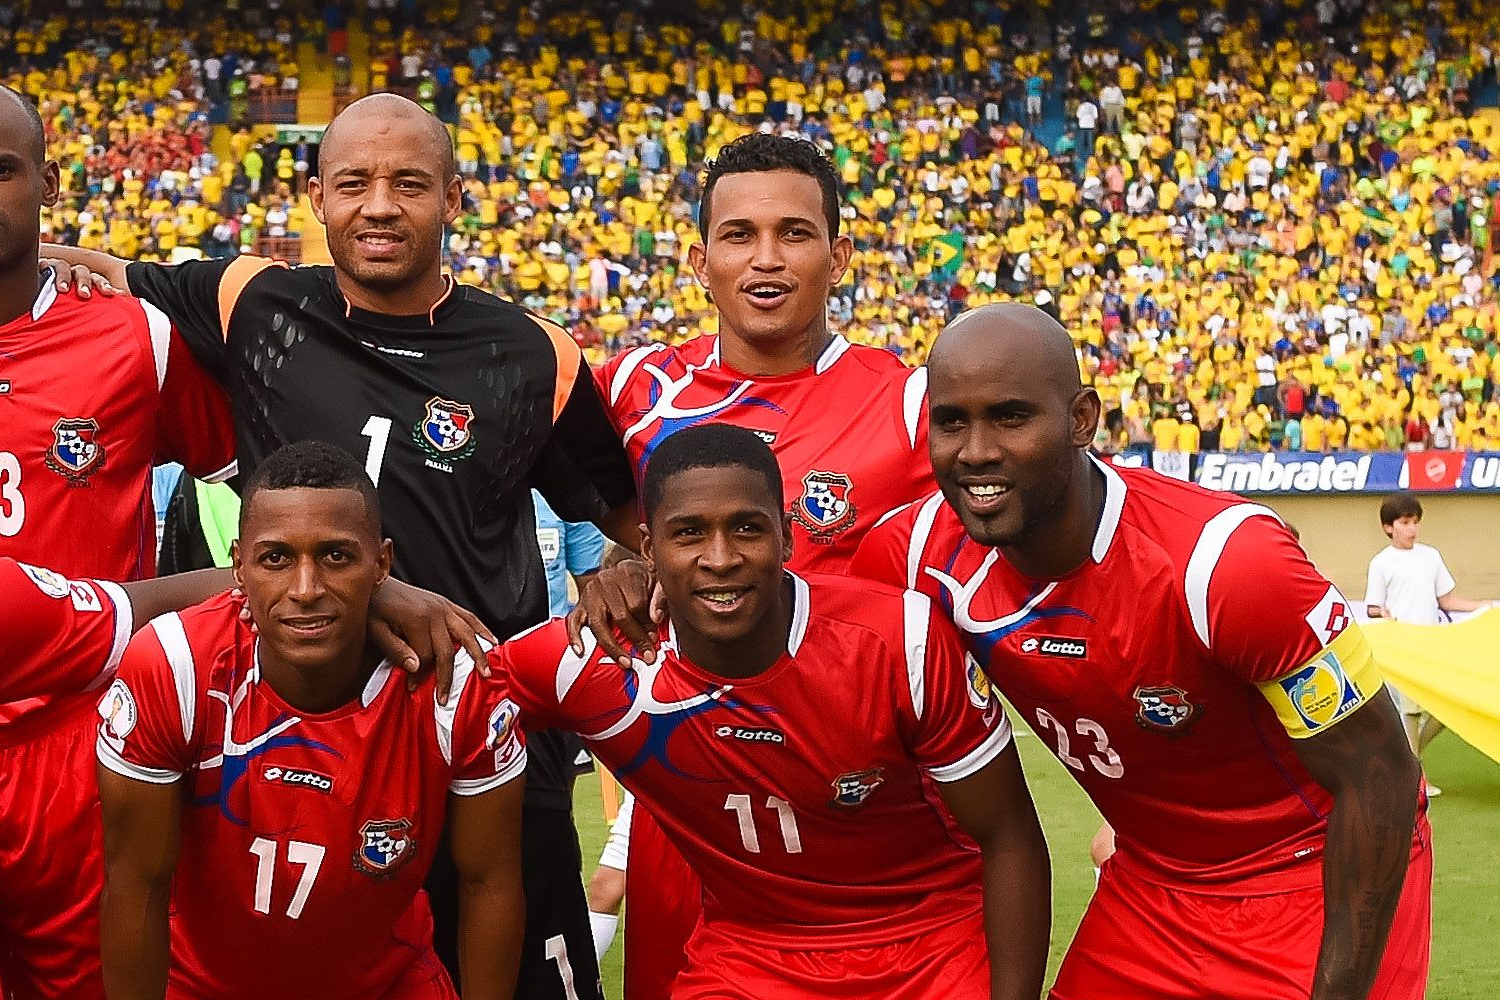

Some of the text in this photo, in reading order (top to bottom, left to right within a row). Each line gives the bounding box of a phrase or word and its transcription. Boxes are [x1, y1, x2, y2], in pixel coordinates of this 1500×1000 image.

[361, 415, 392, 488] 1
[1199, 455, 1372, 491] Embratel
[1036, 708, 1124, 779] 23
[724, 793, 802, 853] 11
[249, 837, 326, 919] 17
